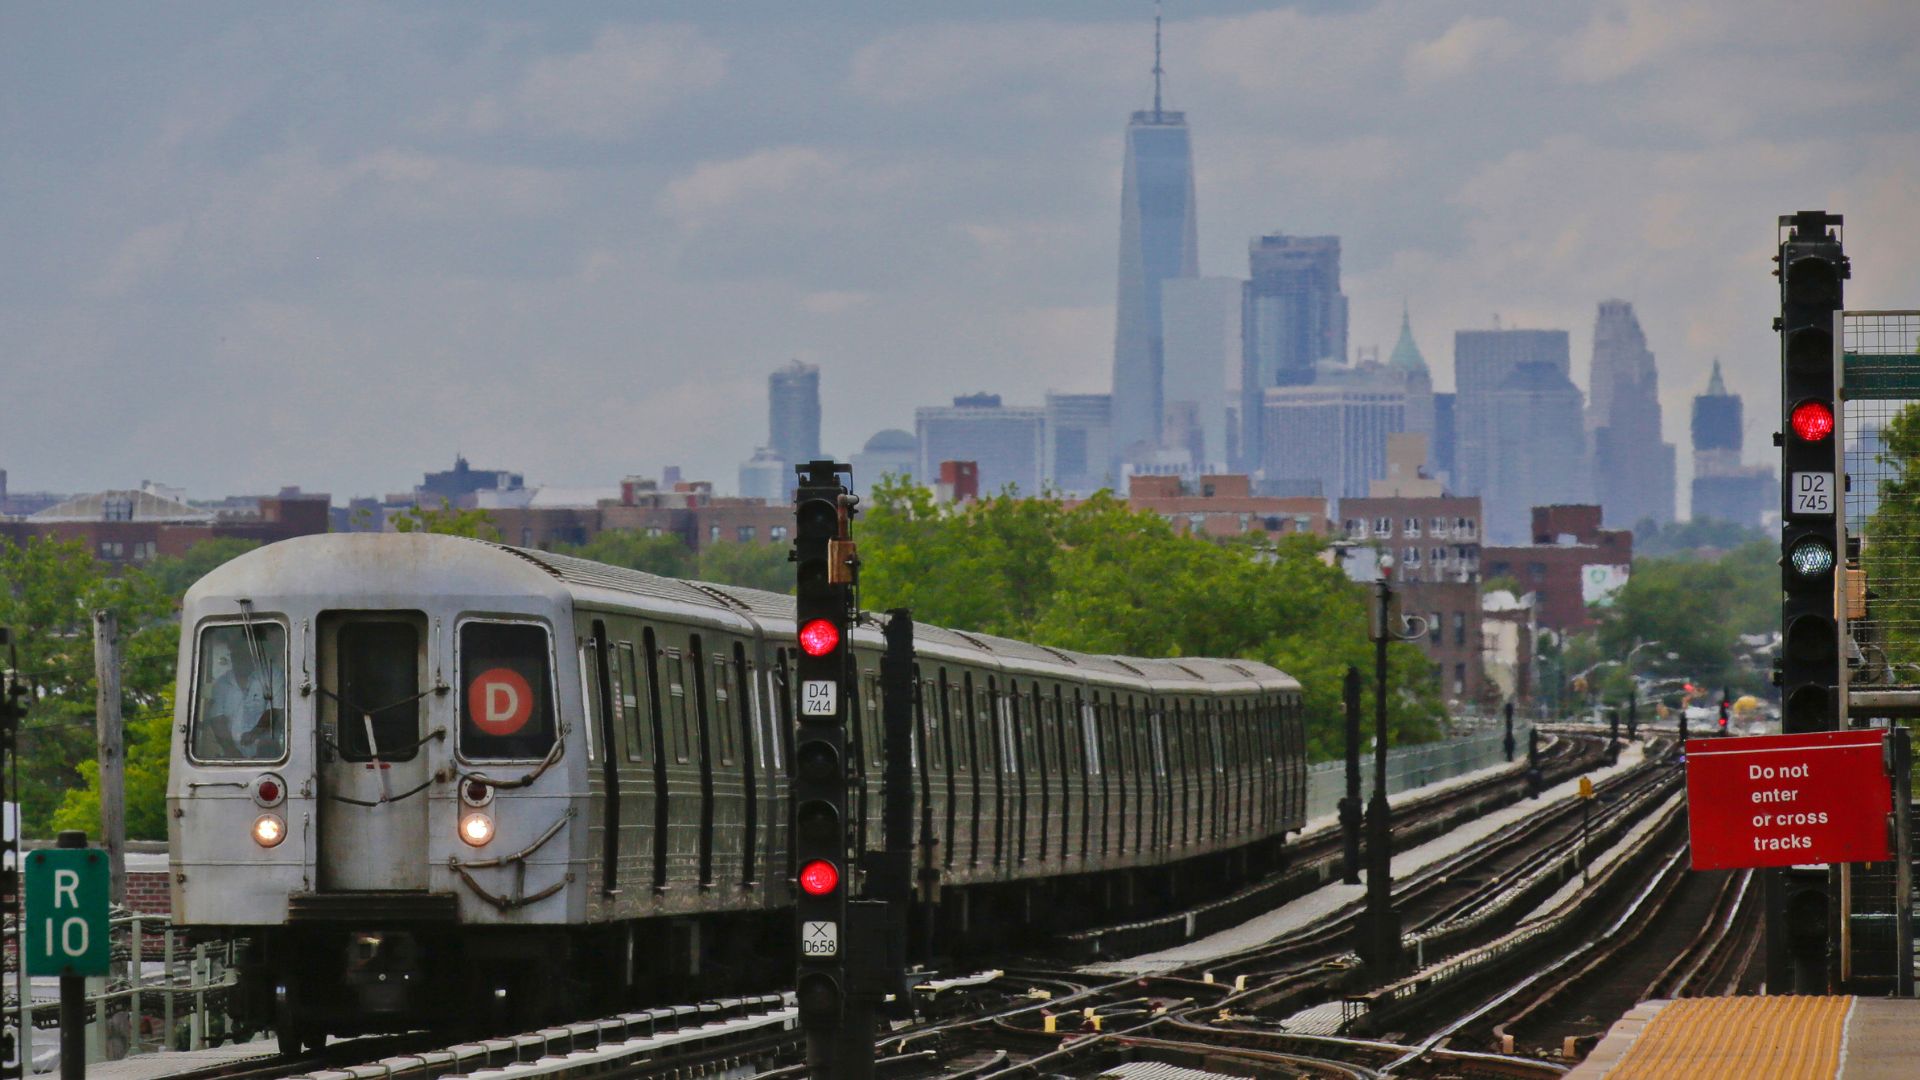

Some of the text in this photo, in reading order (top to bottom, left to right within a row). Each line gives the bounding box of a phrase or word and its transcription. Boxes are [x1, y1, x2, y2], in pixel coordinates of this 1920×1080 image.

[1801, 475, 1824, 492] D2
[1798, 494, 1828, 510] 745
[809, 683, 829, 697] D4
[486, 682, 518, 721] D
[807, 700, 831, 712] 744
[1749, 763, 1809, 779] Do not
[1751, 789, 1798, 803] enter
[1752, 812, 1828, 827] or cross
[1753, 834, 1812, 851] tracks
[54, 869, 80, 909] R
[45, 916, 89, 957] 10
[803, 940, 836, 953] D658
